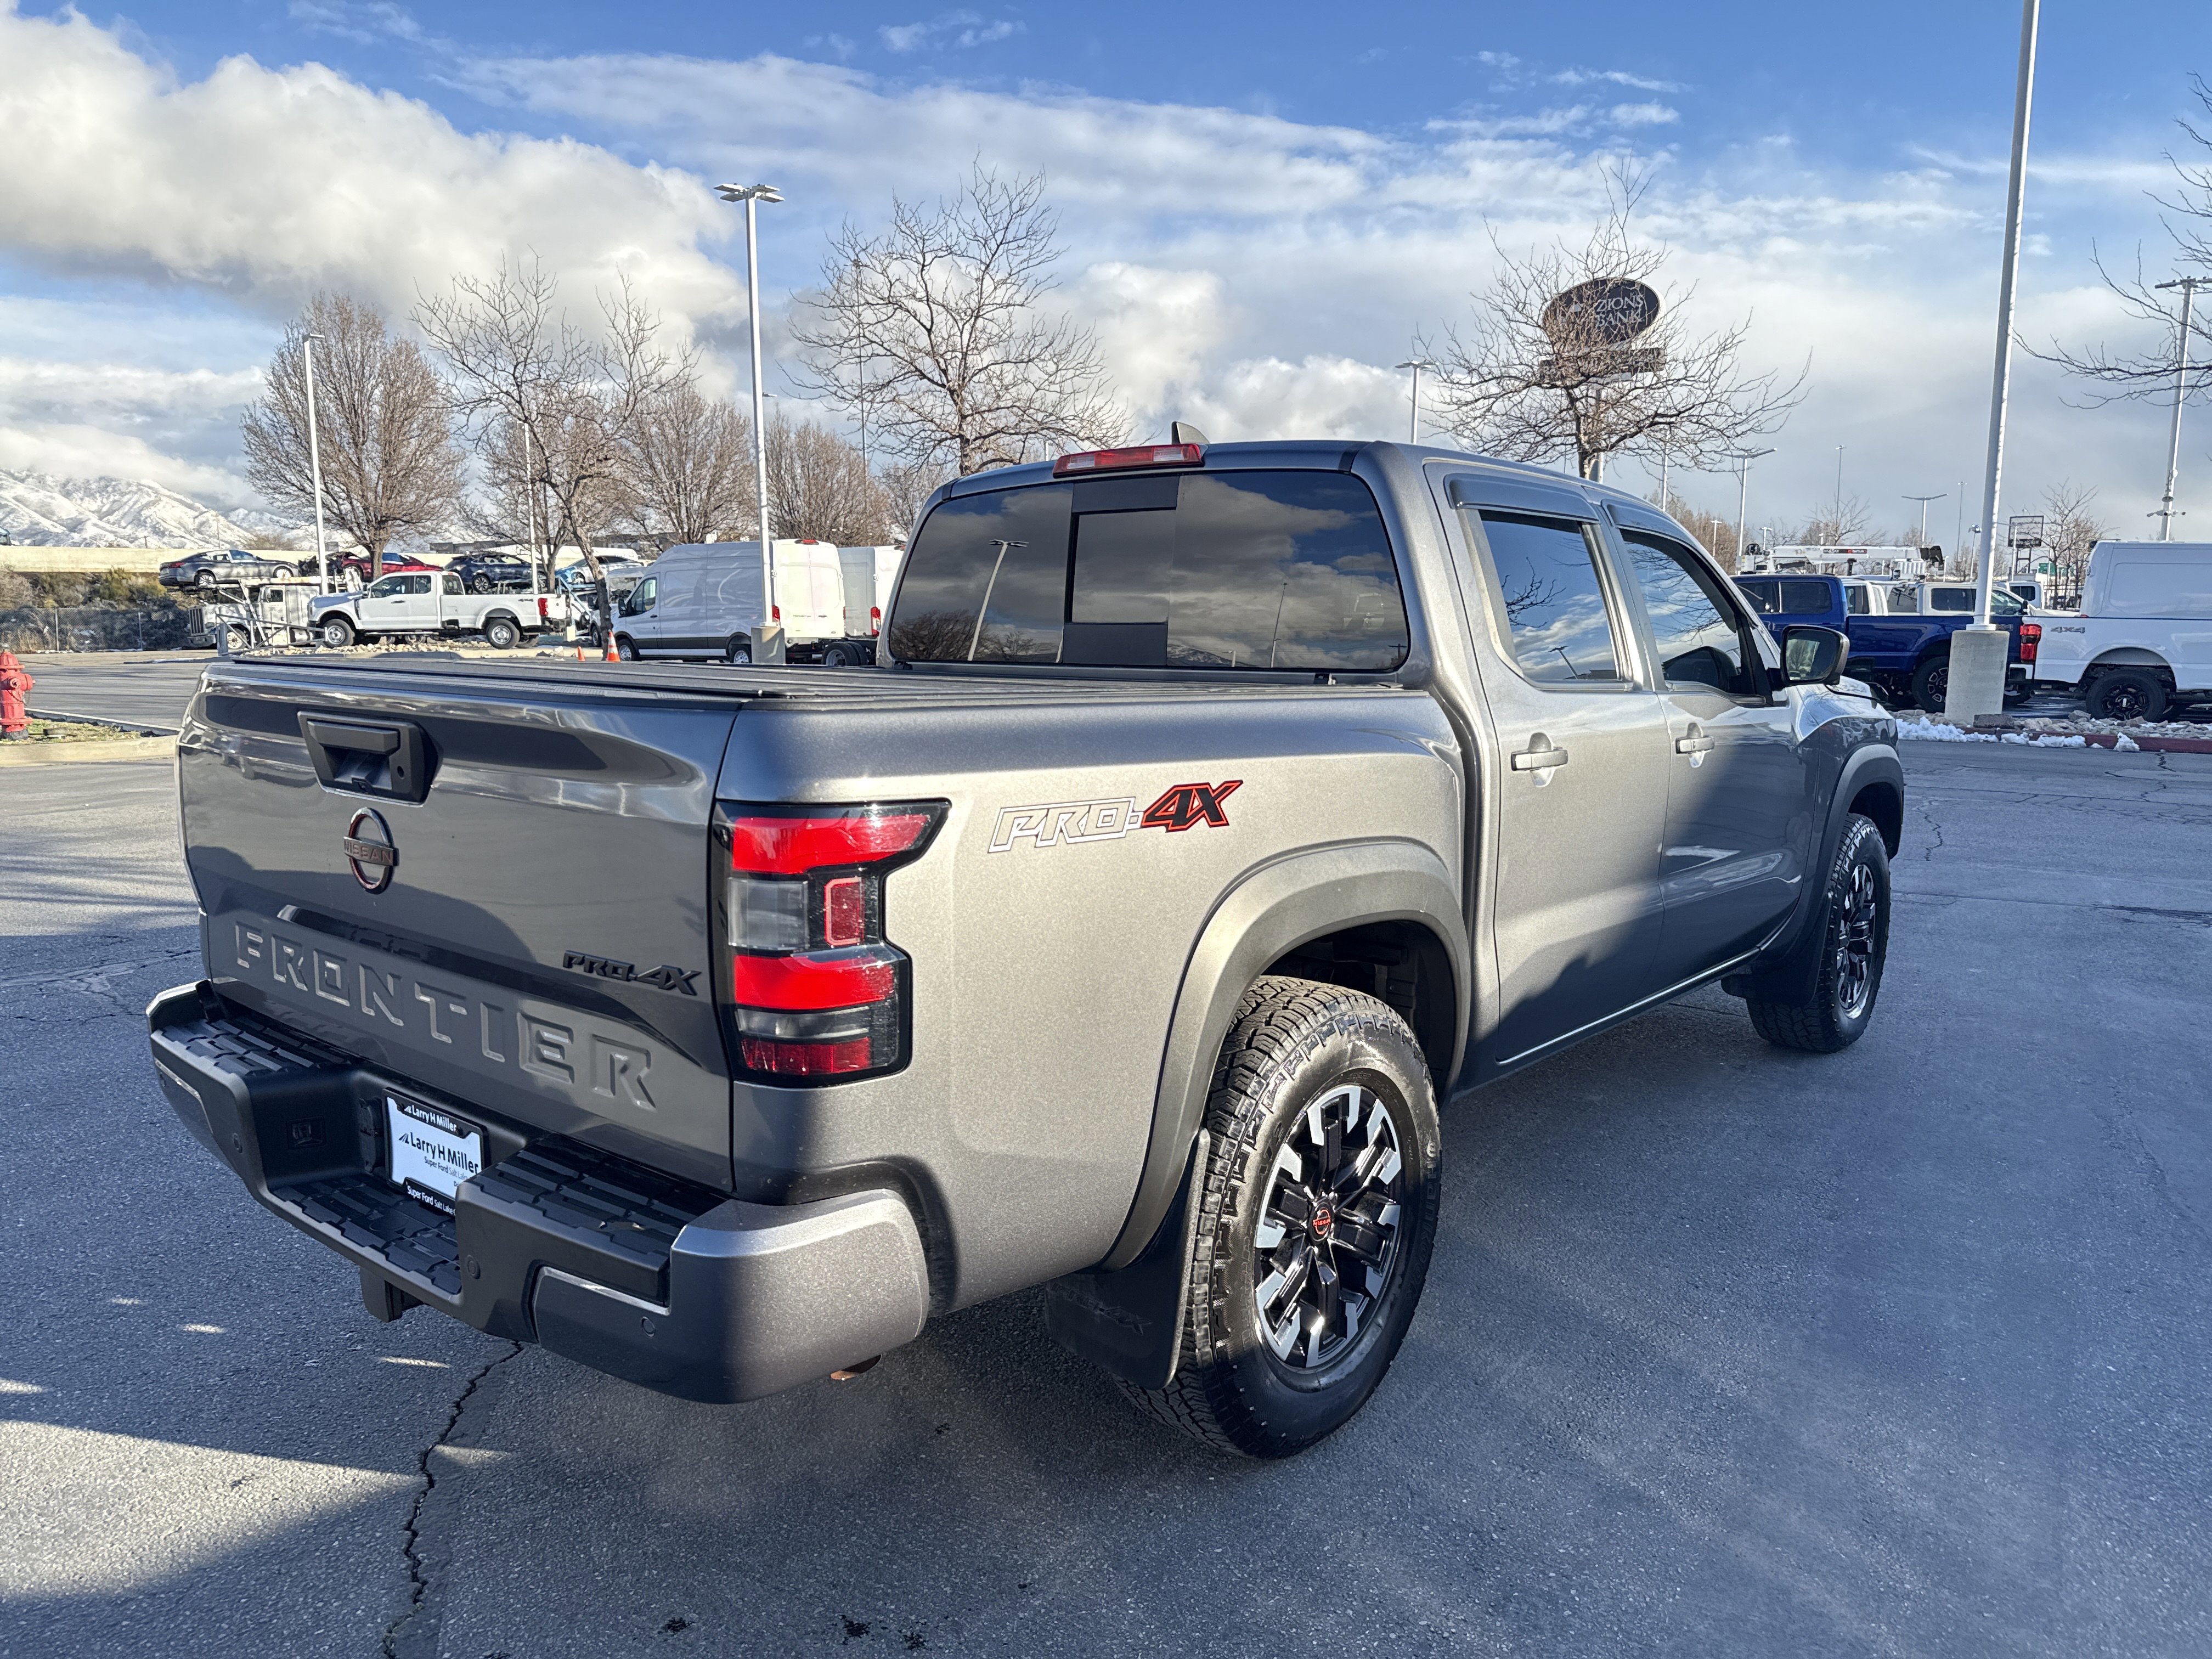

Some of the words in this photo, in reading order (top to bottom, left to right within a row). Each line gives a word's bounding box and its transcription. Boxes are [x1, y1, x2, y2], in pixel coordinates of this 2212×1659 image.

[1596, 295, 1644, 312] ZIONS
[1595, 309, 1643, 328] BANK
[343, 840, 394, 864] NISSAN
[563, 950, 702, 996] PRO-4X
[234, 920, 657, 1112] FRONTIER
[412, 1104, 429, 1123] Larry
[430, 1112, 436, 1124] H
[436, 1114, 457, 1132] Miller
[410, 1131, 436, 1159] Larry
[438, 1143, 445, 1161] H
[448, 1148, 479, 1175] Miller
[425, 1155, 438, 1169] Super
[438, 1162, 448, 1173] Ford
[407, 1185, 421, 1199] Super
[421, 1192, 433, 1205] Ford
[434, 1199, 443, 1210] Salt
[442, 1203, 453, 1215] Lake
[1312, 1217, 1331, 1226] NISSAN
